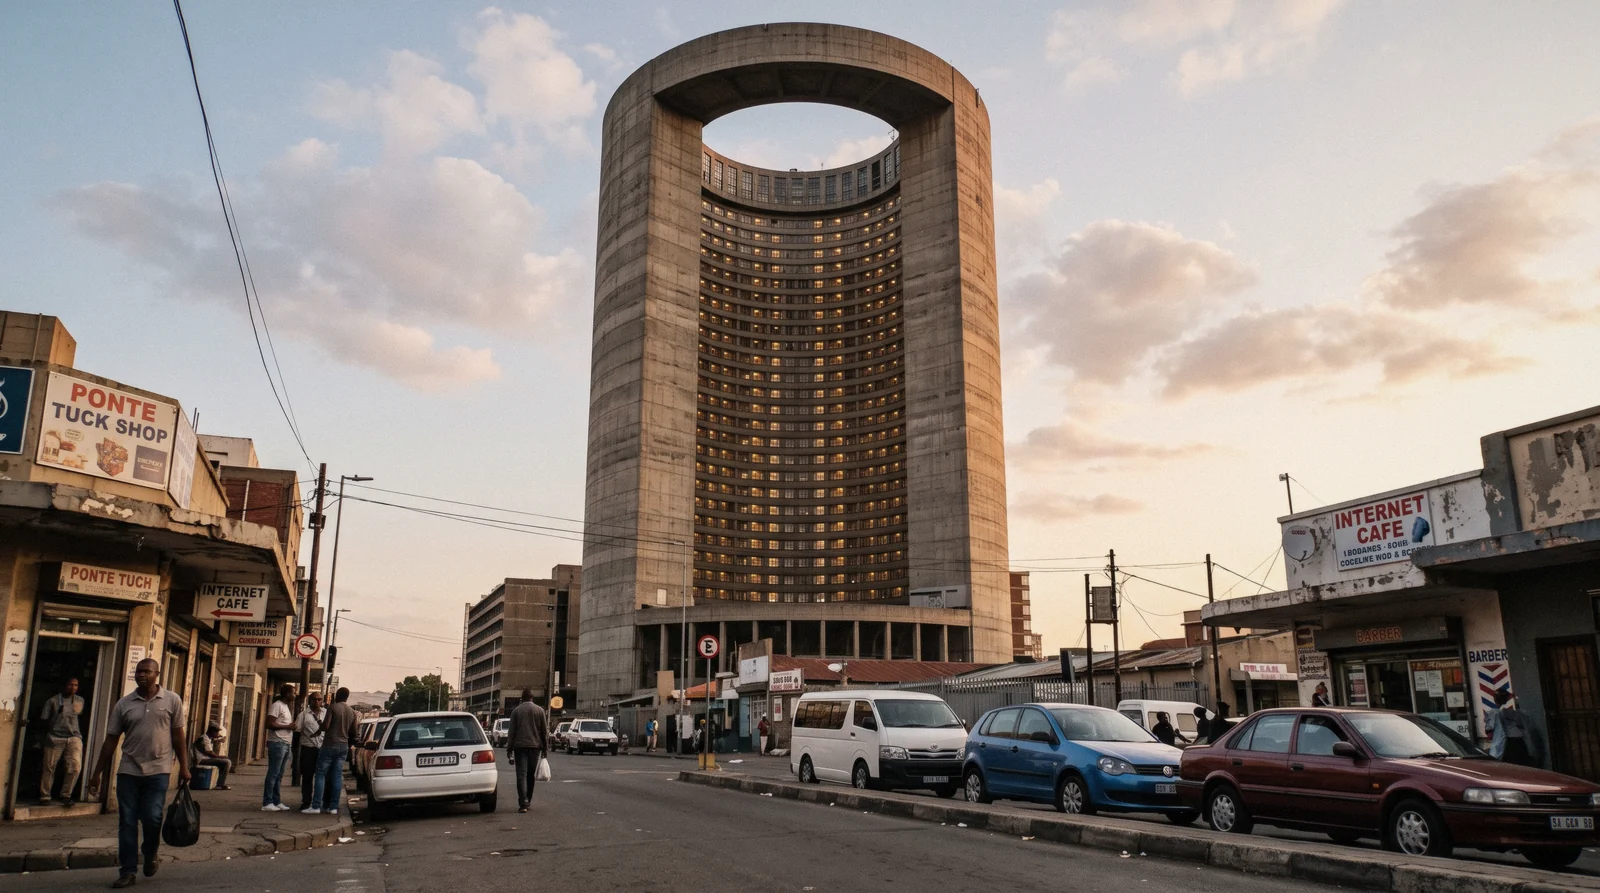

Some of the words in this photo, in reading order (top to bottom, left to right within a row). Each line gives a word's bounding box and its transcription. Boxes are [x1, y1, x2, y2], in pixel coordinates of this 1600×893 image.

[71, 382, 157, 422] PONTE
[52, 402, 110, 431] TUCK
[116, 418, 168, 443] SHOP
[1335, 494, 1424, 530] INTERNET
[1357, 520, 1404, 544] CAFE
[1376, 552, 1392, 561] WOD
[70, 566, 115, 585] PONTE
[119, 573, 152, 589] TUCH
[202, 585, 265, 598] INTERNET
[217, 598, 249, 609] CAFE
[1356, 627, 1402, 643] BARBER
[1469, 649, 1508, 663] BARBER
